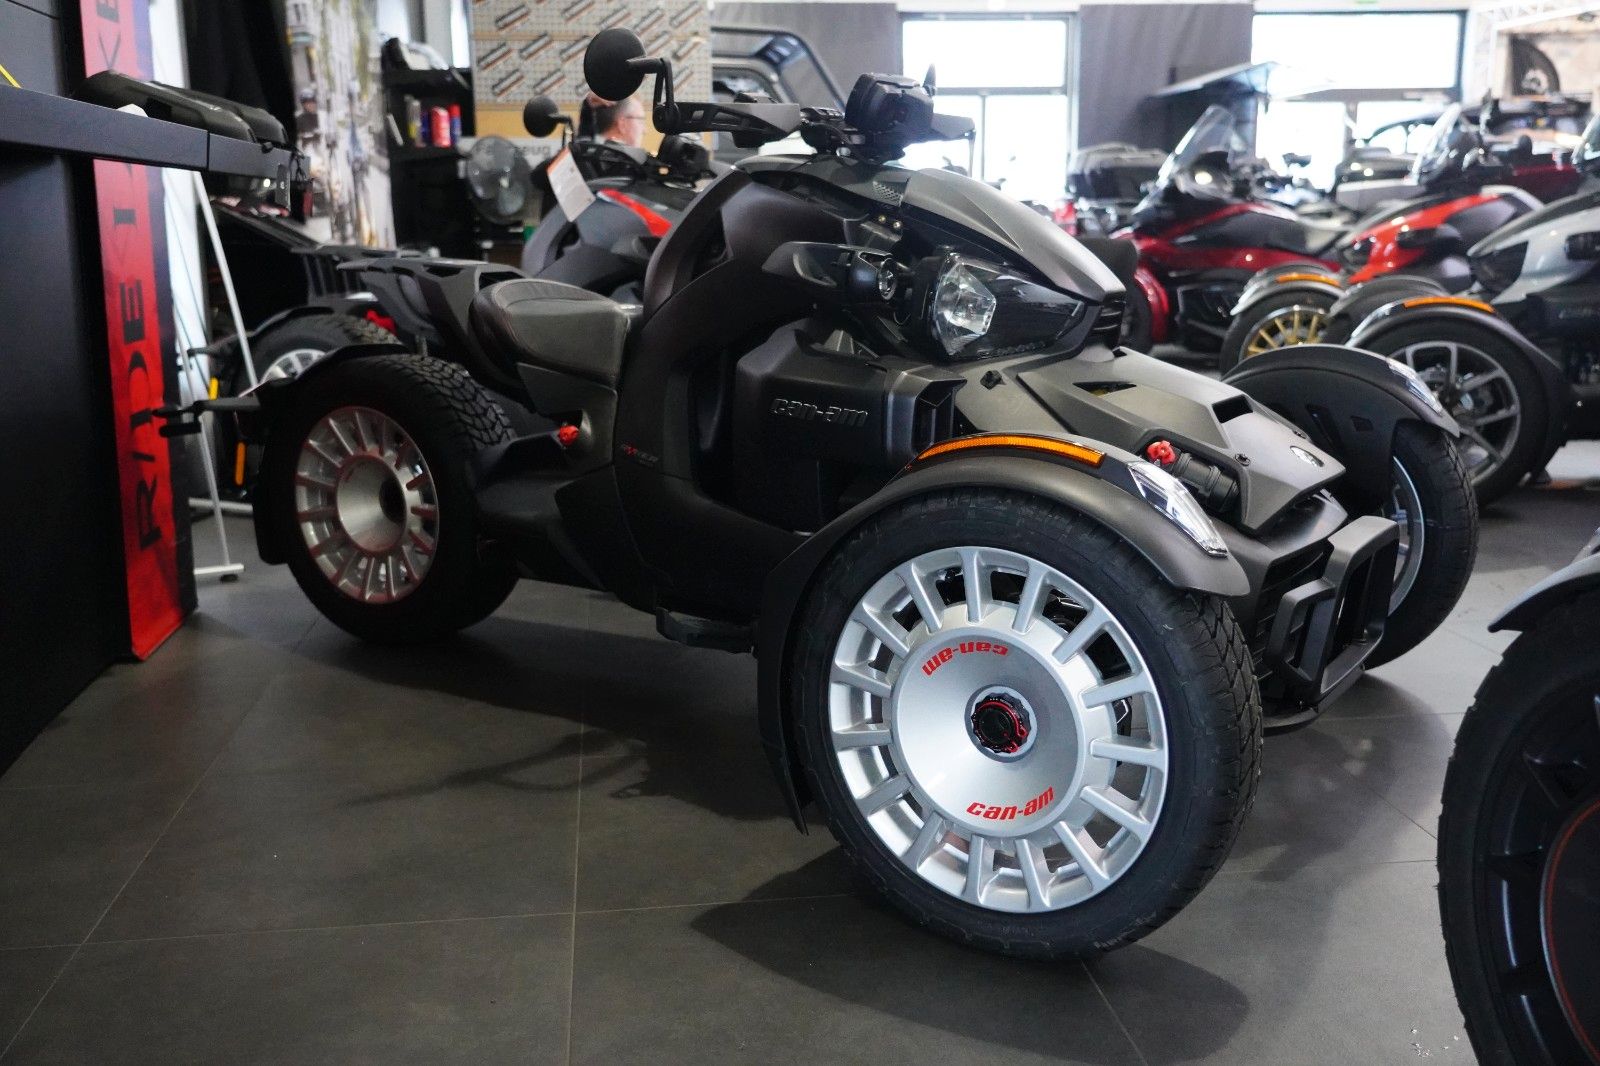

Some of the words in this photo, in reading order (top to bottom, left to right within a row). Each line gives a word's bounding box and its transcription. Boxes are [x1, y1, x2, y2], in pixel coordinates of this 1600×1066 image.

[771, 398, 868, 426] can-am
[922, 642, 1008, 677] can-am
[966, 786, 1055, 820] can-am
